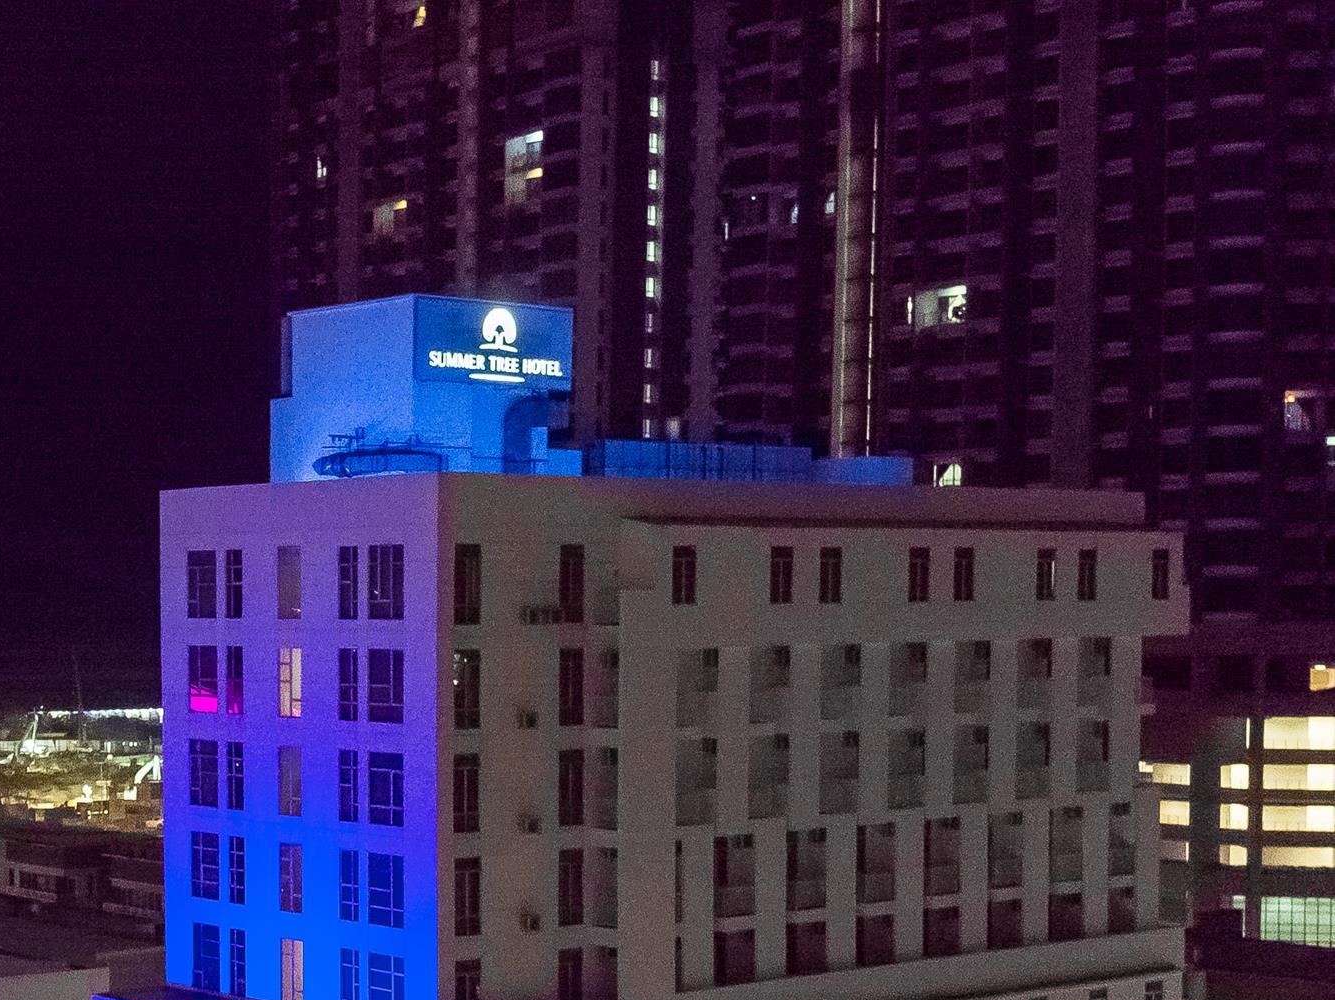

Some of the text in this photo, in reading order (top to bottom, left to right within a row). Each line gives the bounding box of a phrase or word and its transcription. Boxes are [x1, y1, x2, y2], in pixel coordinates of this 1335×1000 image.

[429, 351, 562, 376] SUMMER TREE HOTEL
